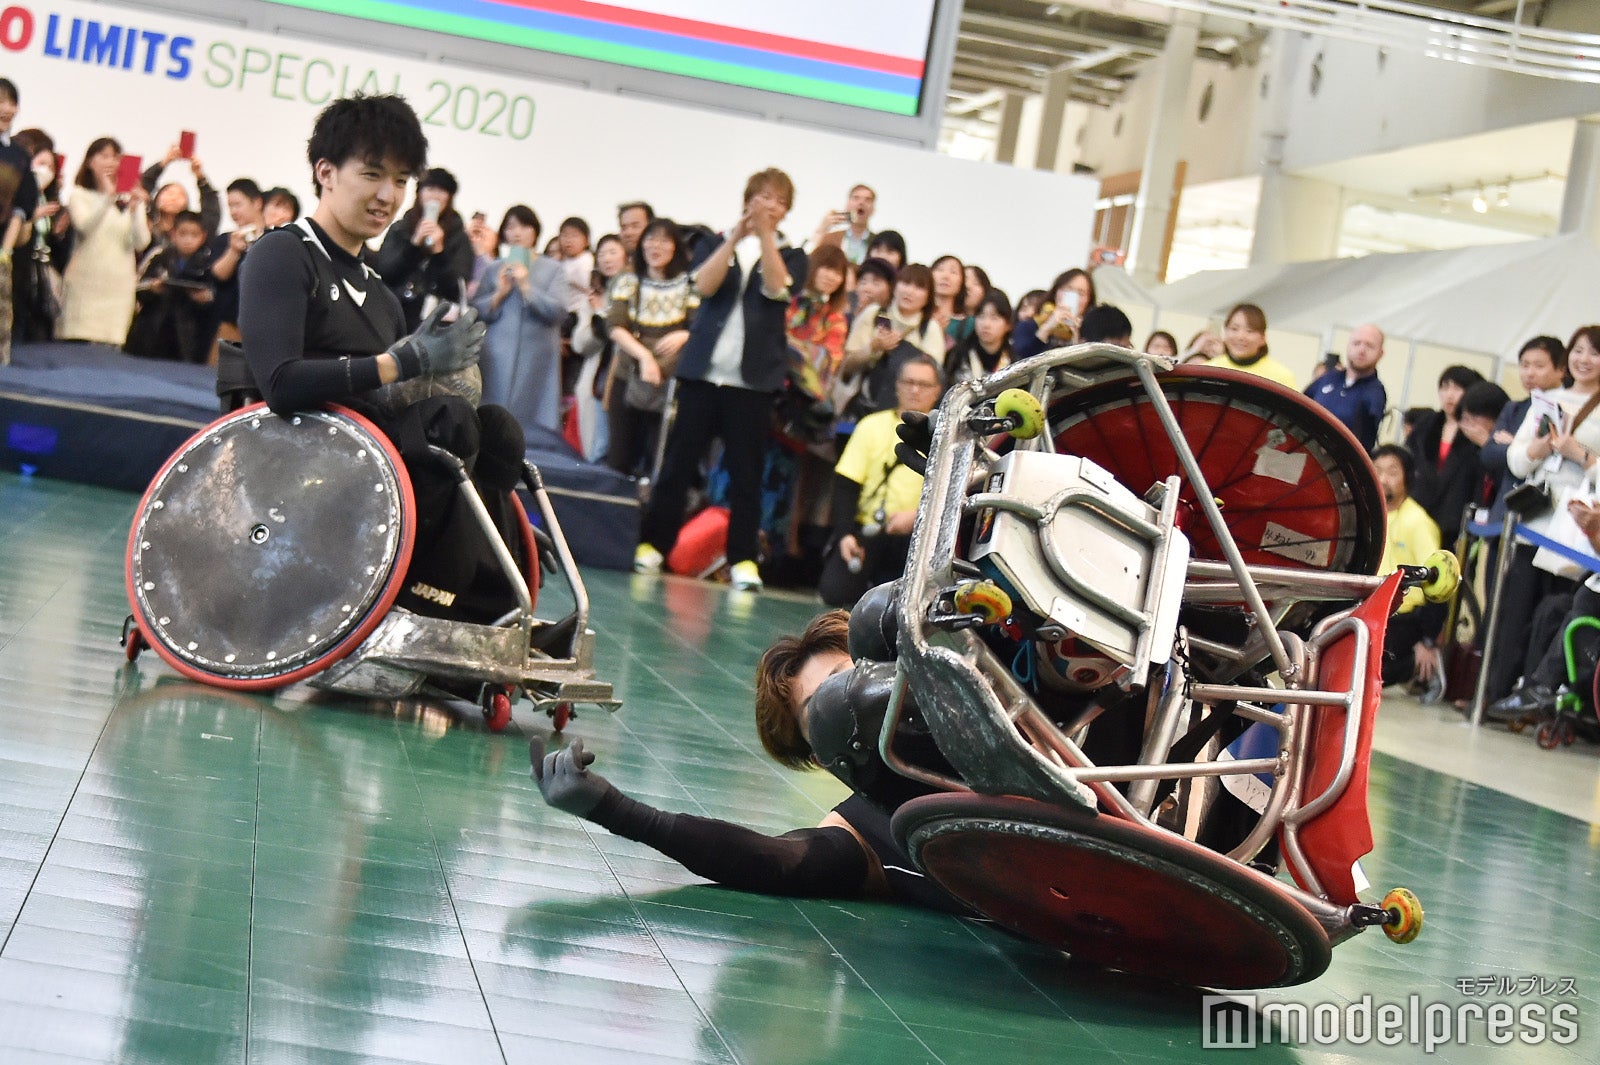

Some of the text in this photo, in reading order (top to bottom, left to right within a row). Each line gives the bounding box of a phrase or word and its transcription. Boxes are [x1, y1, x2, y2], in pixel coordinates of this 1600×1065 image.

[43, 13, 195, 80] LIMITS
[424, 79, 536, 141] 2020
[411, 582, 457, 607] JAPAN
